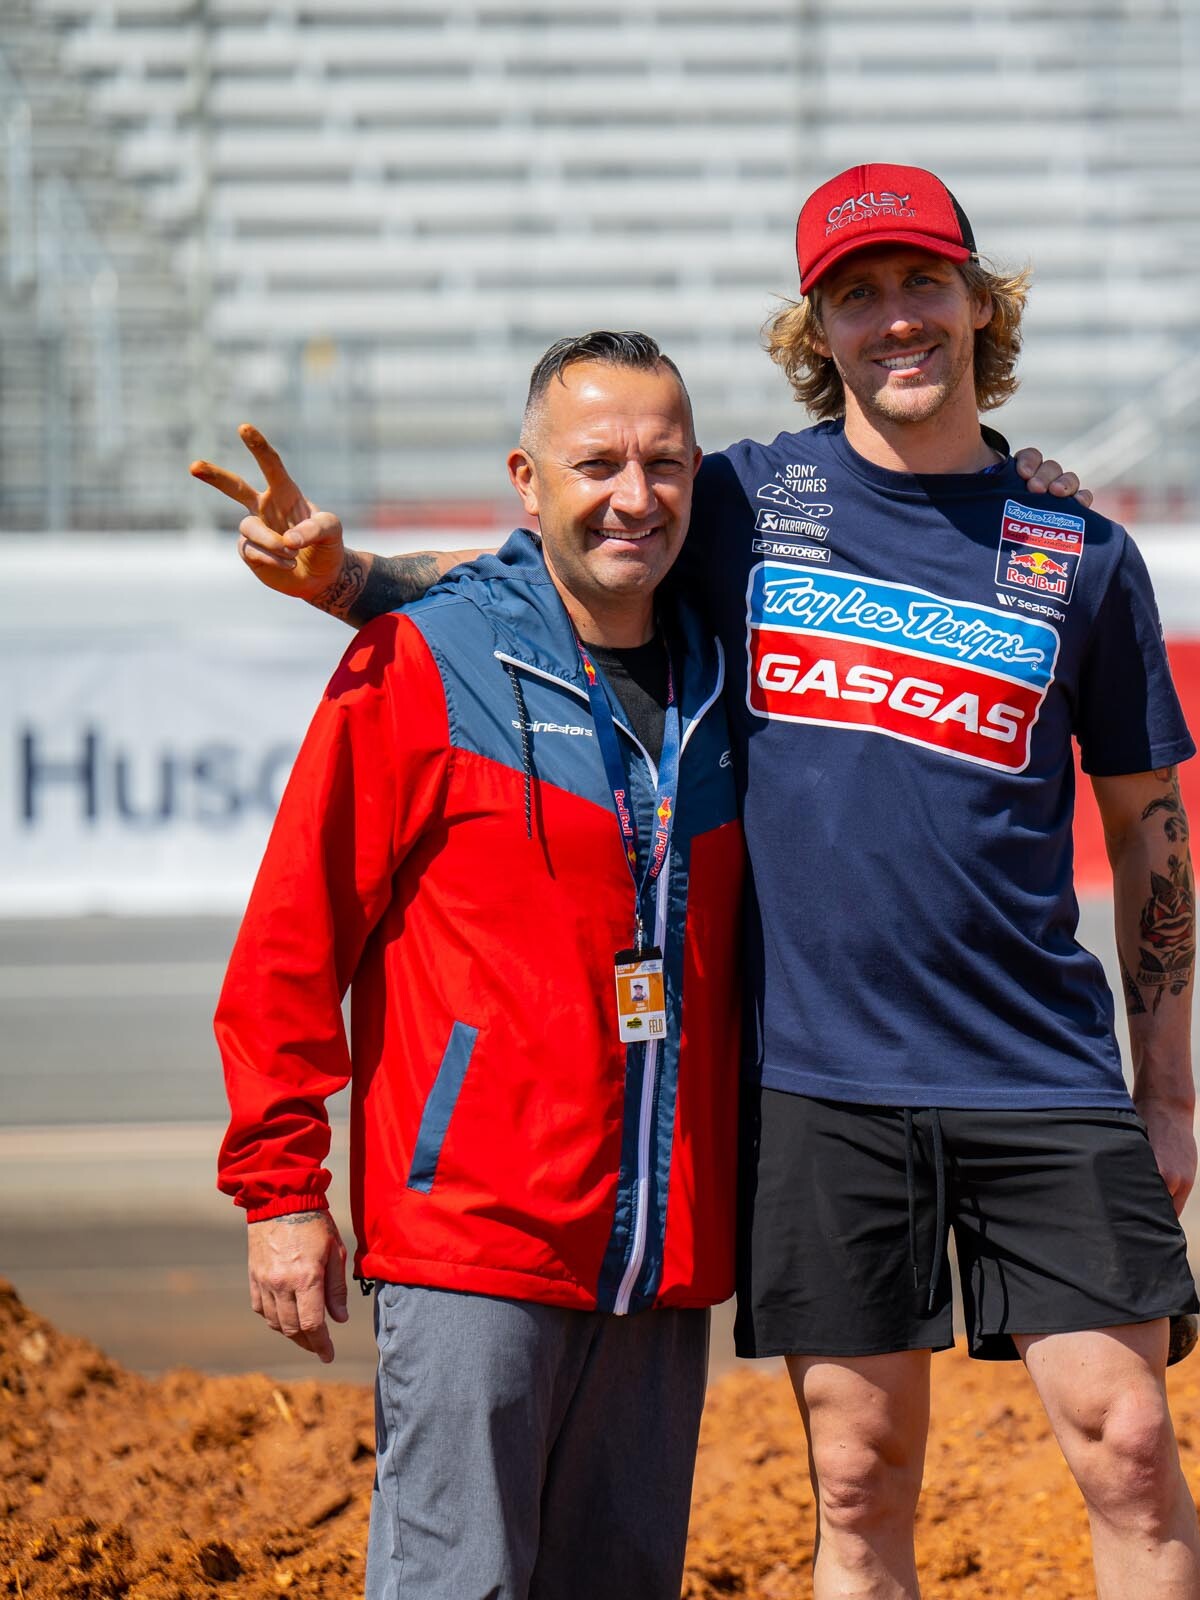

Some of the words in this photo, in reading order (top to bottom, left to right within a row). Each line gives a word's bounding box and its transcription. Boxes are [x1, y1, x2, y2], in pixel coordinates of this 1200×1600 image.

[826, 192, 911, 223] OAKLEY
[825, 208, 881, 237] FACTORY
[882, 207, 916, 217] PILOT
[786, 464, 817, 478] SONY
[1008, 504, 1026, 520] Troy
[1025, 510, 1042, 522] Lee
[1042, 513, 1082, 530] Designs
[1008, 523, 1080, 544] GASGAS
[772, 543, 827, 560] MOTOREX
[1007, 567, 1036, 588] Red
[1036, 574, 1066, 595] Bull
[763, 577, 839, 626] Troy
[832, 586, 904, 631] Lee
[902, 601, 1045, 664] Designs
[1017, 599, 1066, 622] seaspan
[757, 653, 1025, 744] GASGAS
[511, 720, 593, 737] apinestars
[614, 790, 629, 814] Red
[620, 813, 633, 836] Bull
[655, 831, 668, 855] Bull
[649, 853, 663, 878] Red
